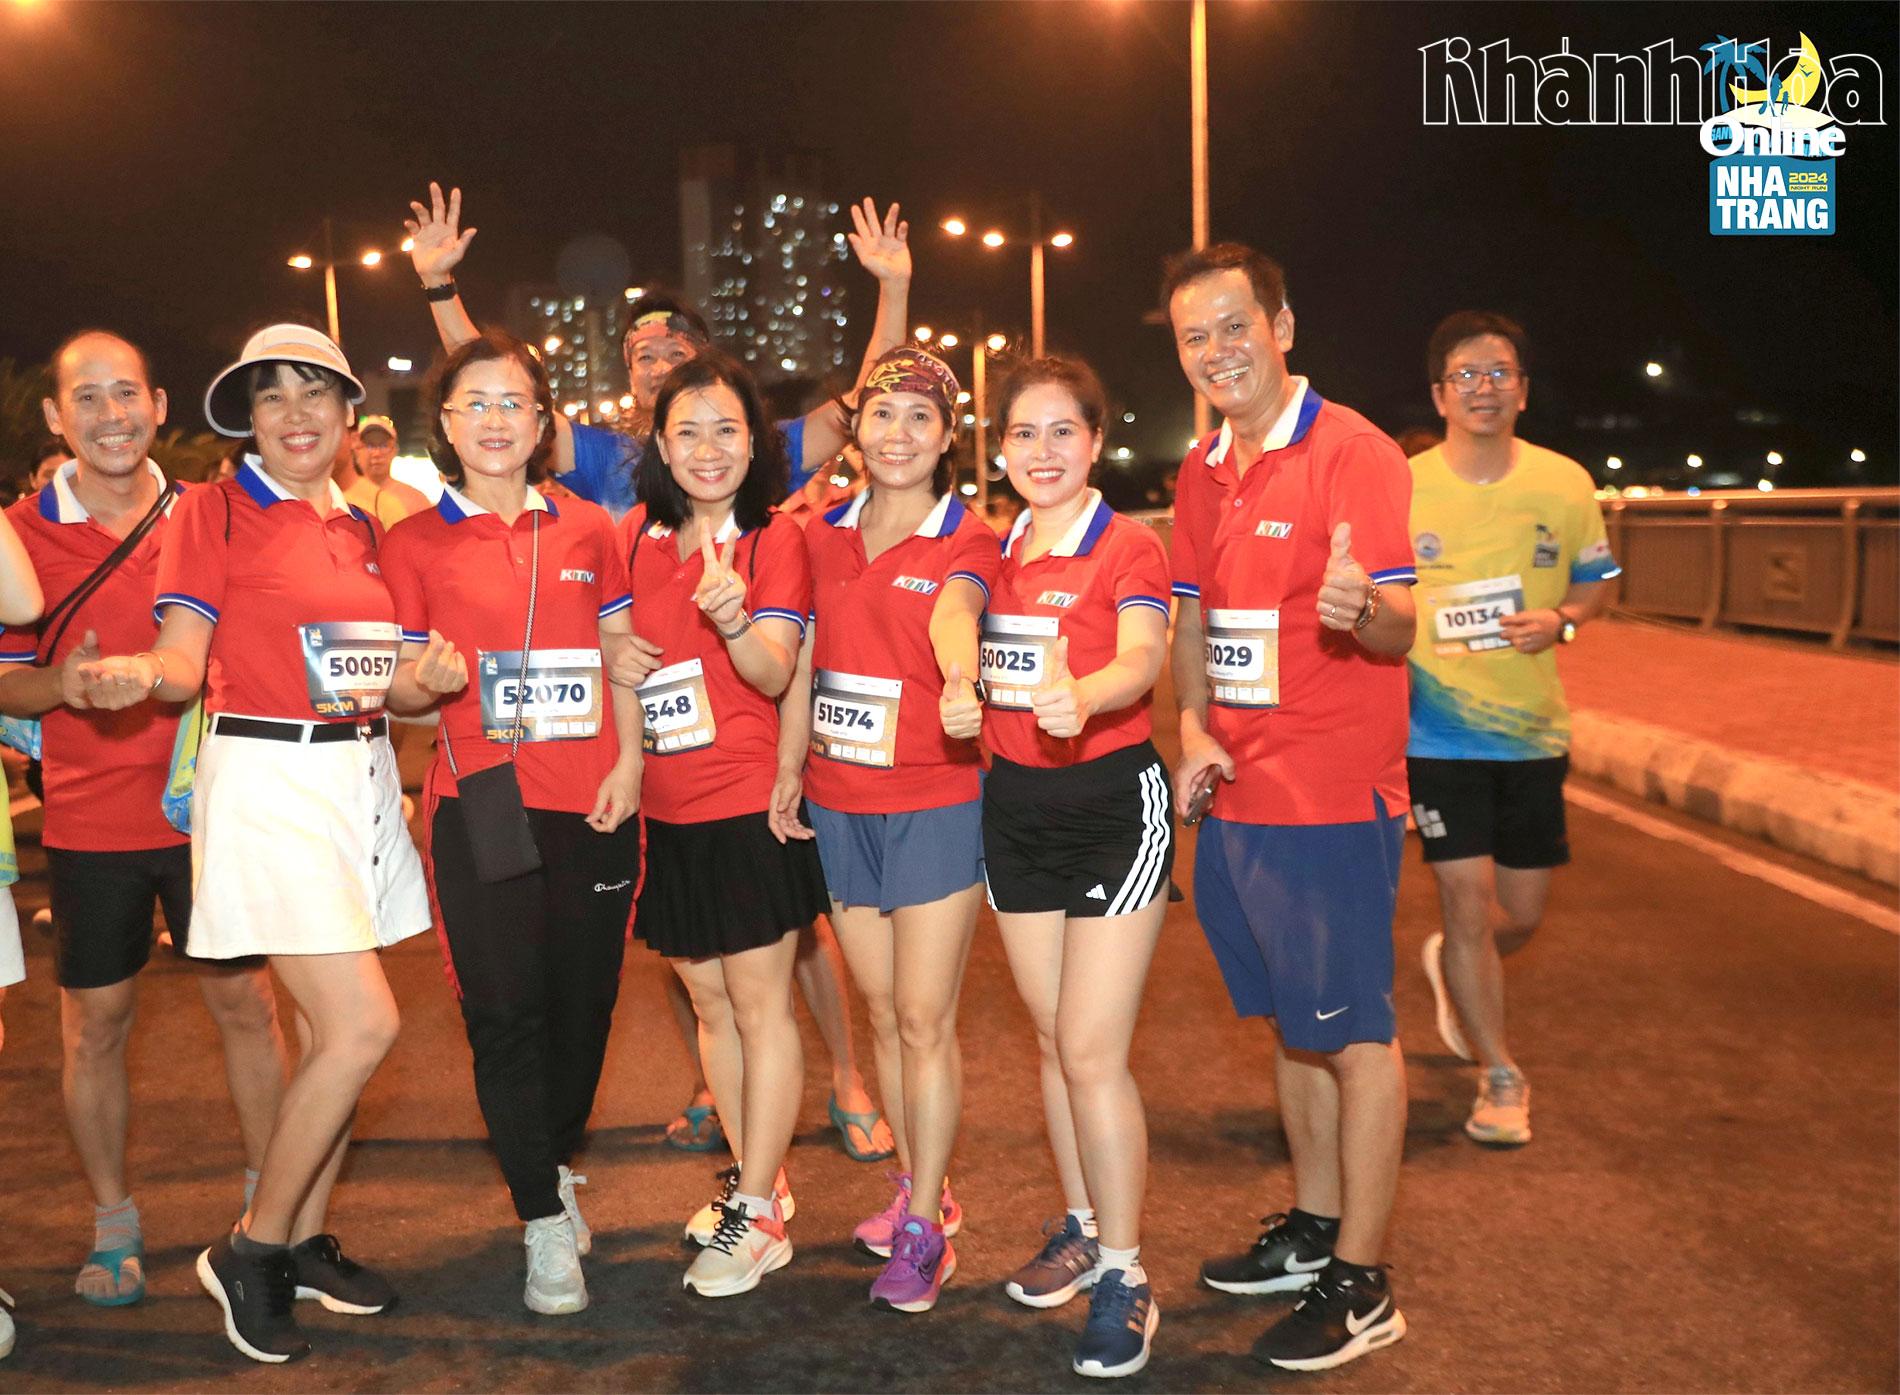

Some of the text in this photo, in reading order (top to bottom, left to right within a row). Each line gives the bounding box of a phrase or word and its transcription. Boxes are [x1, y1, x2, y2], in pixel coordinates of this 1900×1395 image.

[1255, 520, 1293, 539] KTV
[560, 569, 594, 584] KTV
[892, 575, 938, 595] KTV
[1445, 605, 1504, 628] 10134
[330, 656, 393, 677] 50057
[982, 647, 1036, 671] 50025
[503, 683, 586, 705] 52070
[316, 701, 354, 713] 5KM
[818, 702, 875, 730] 51574
